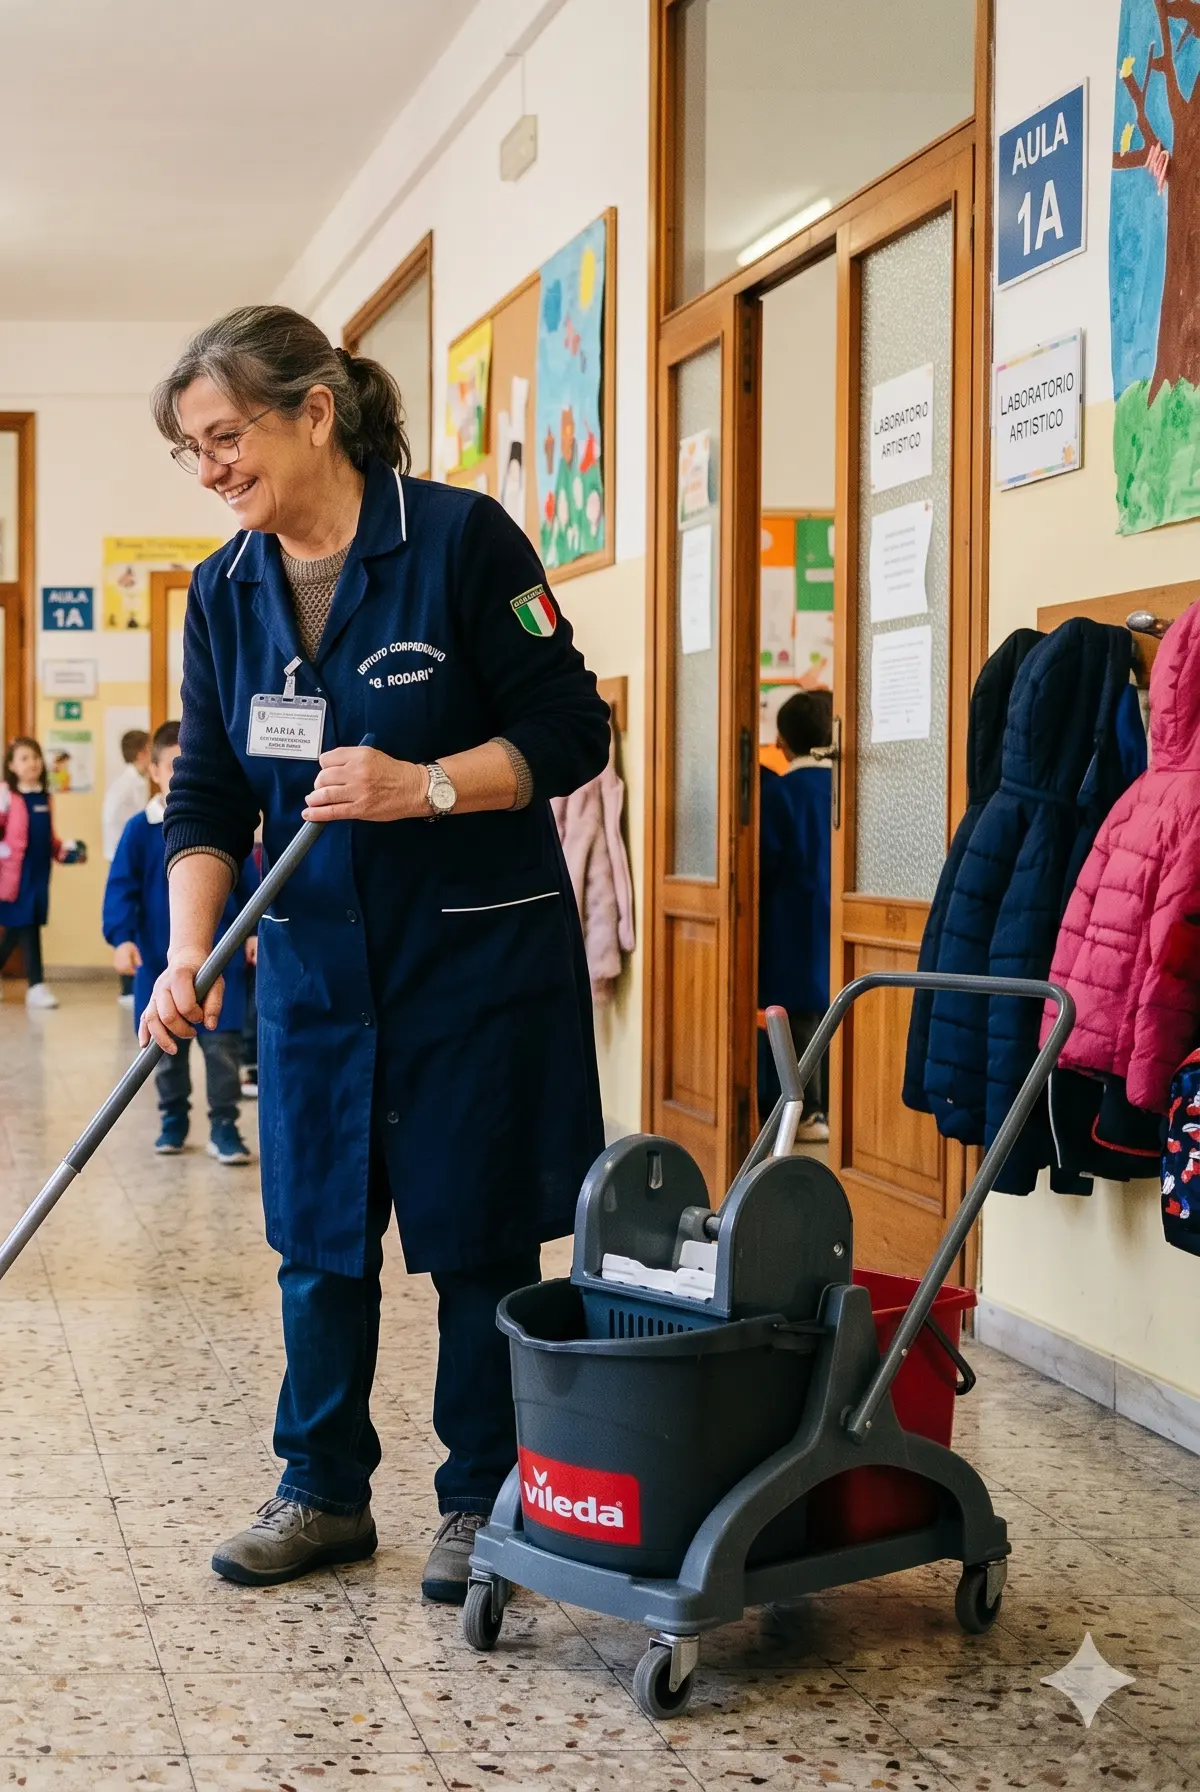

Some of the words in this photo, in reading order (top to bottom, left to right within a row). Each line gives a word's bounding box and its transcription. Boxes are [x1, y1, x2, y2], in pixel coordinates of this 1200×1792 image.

[1012, 112, 1068, 176] AULA
[1017, 179, 1064, 256] 1A
[1000, 372, 1074, 416] LABORATORIO
[874, 401, 929, 435] LABORATORIO
[1009, 408, 1064, 443] ARTISTICO
[881, 432, 921, 459] ARTISTICO
[52, 607, 84, 628] 1A
[265, 726, 296, 736] MARIA
